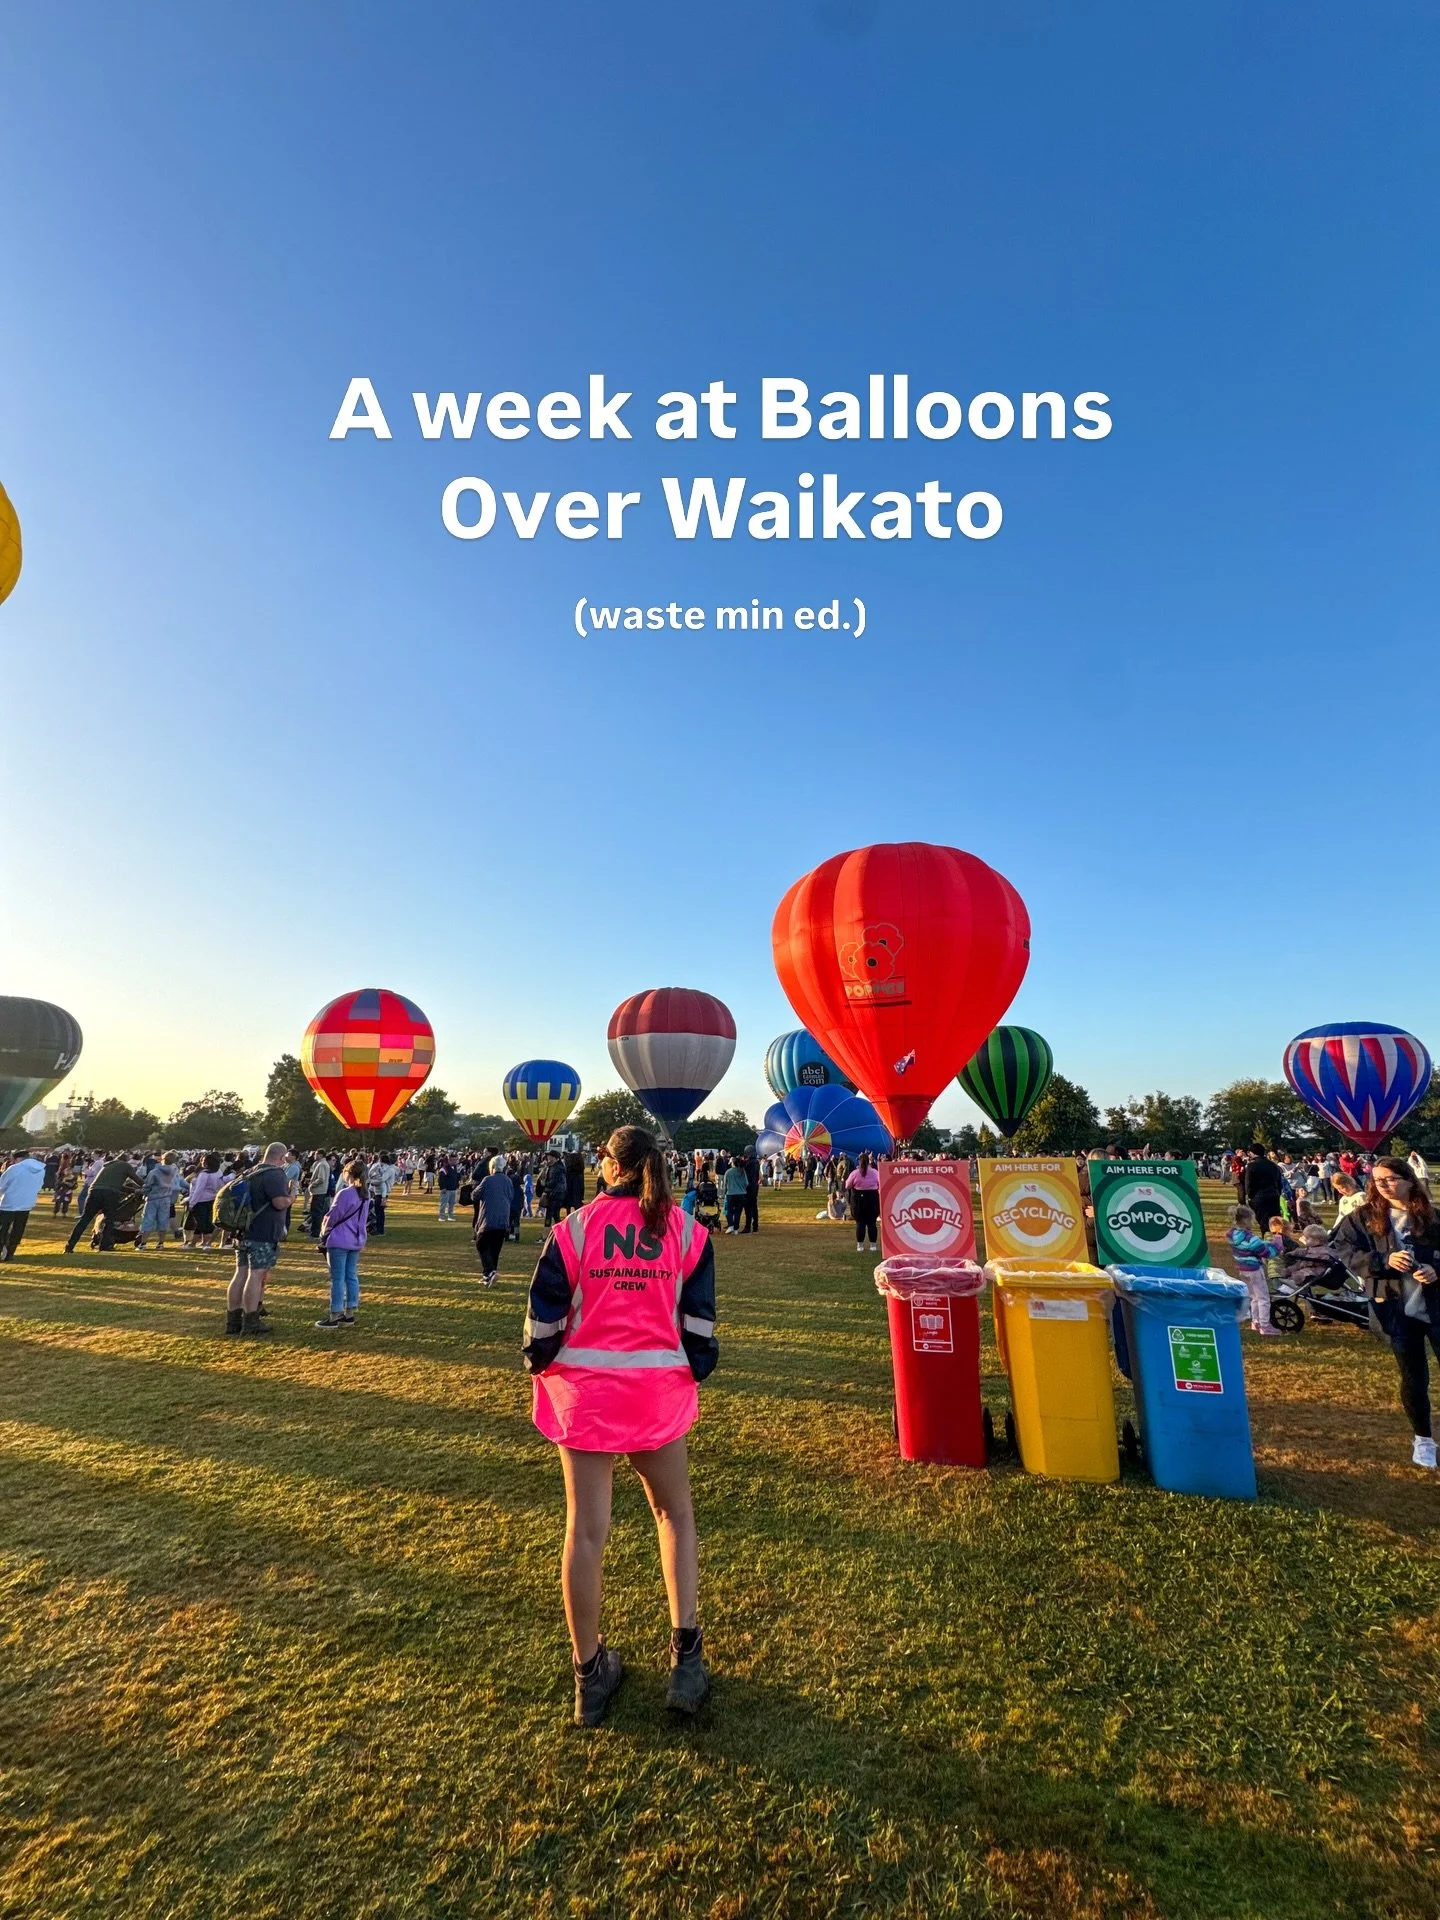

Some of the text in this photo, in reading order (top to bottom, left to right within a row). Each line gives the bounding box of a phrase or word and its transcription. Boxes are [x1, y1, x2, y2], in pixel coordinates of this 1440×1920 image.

[892, 1166, 954, 1174] AIM HERE FOR
[994, 1163, 1062, 1172] AIM HERE FOR
[1106, 1165, 1179, 1175] AIM HERE FOR
[890, 1207, 963, 1229] LANDFILL
[992, 1206, 1076, 1229] RECYCLING
[1108, 1211, 1190, 1232] COMPOST
[603, 1223, 664, 1260] NS
[613, 1281, 647, 1291] CREW
